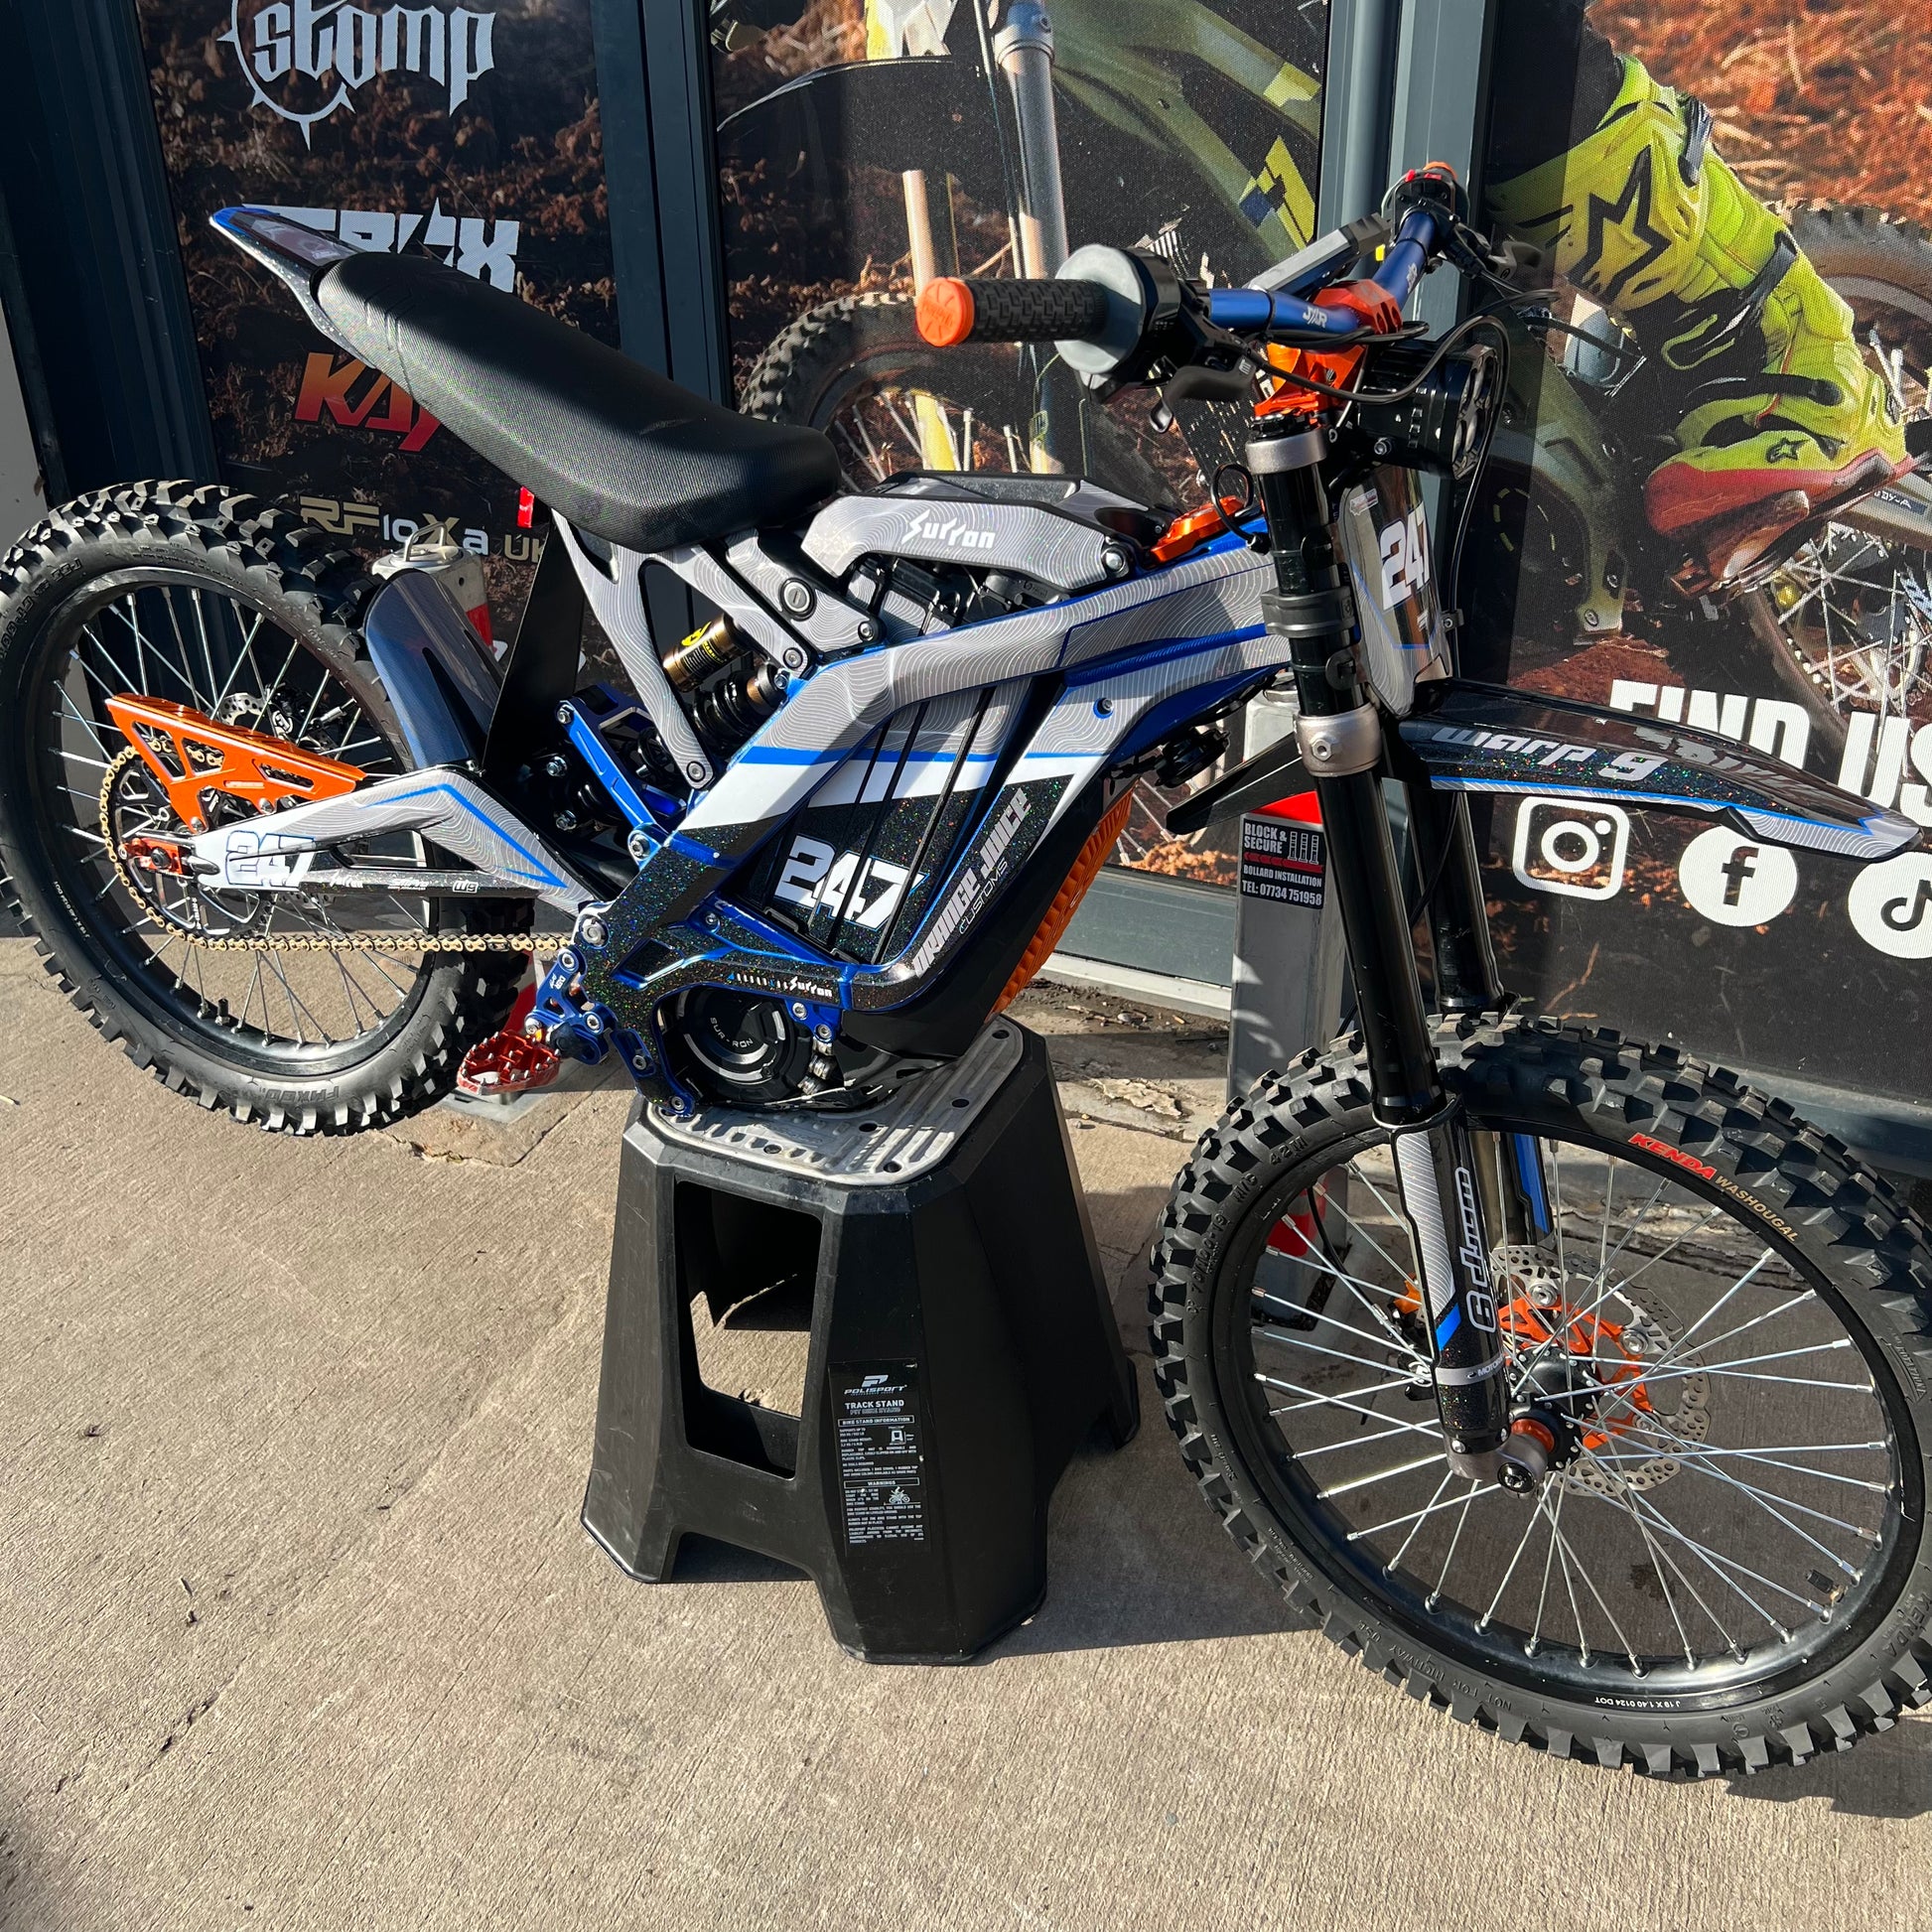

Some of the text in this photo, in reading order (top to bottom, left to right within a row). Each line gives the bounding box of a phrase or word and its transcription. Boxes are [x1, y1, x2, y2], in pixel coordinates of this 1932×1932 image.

[1432, 727, 1670, 782] warp 9
[979, 787, 1032, 881] JUICE
[1243, 835, 1283, 854] SECURE
[1244, 822, 1288, 843] BLOCK &
[773, 832, 931, 932] 247
[1243, 864, 1322, 888] BOLLARD INSTALLATION
[958, 857, 1008, 935] CUSTOMS
[1242, 880, 1322, 906] TEL: 07734 751958
[1627, 1133, 1800, 1242] KENDA WASHOUGAL
[843, 1384, 905, 1395] POLISPORT
[845, 1399, 904, 1410] TRACK STAND
[1594, 1696, 1614, 1706] DOT
